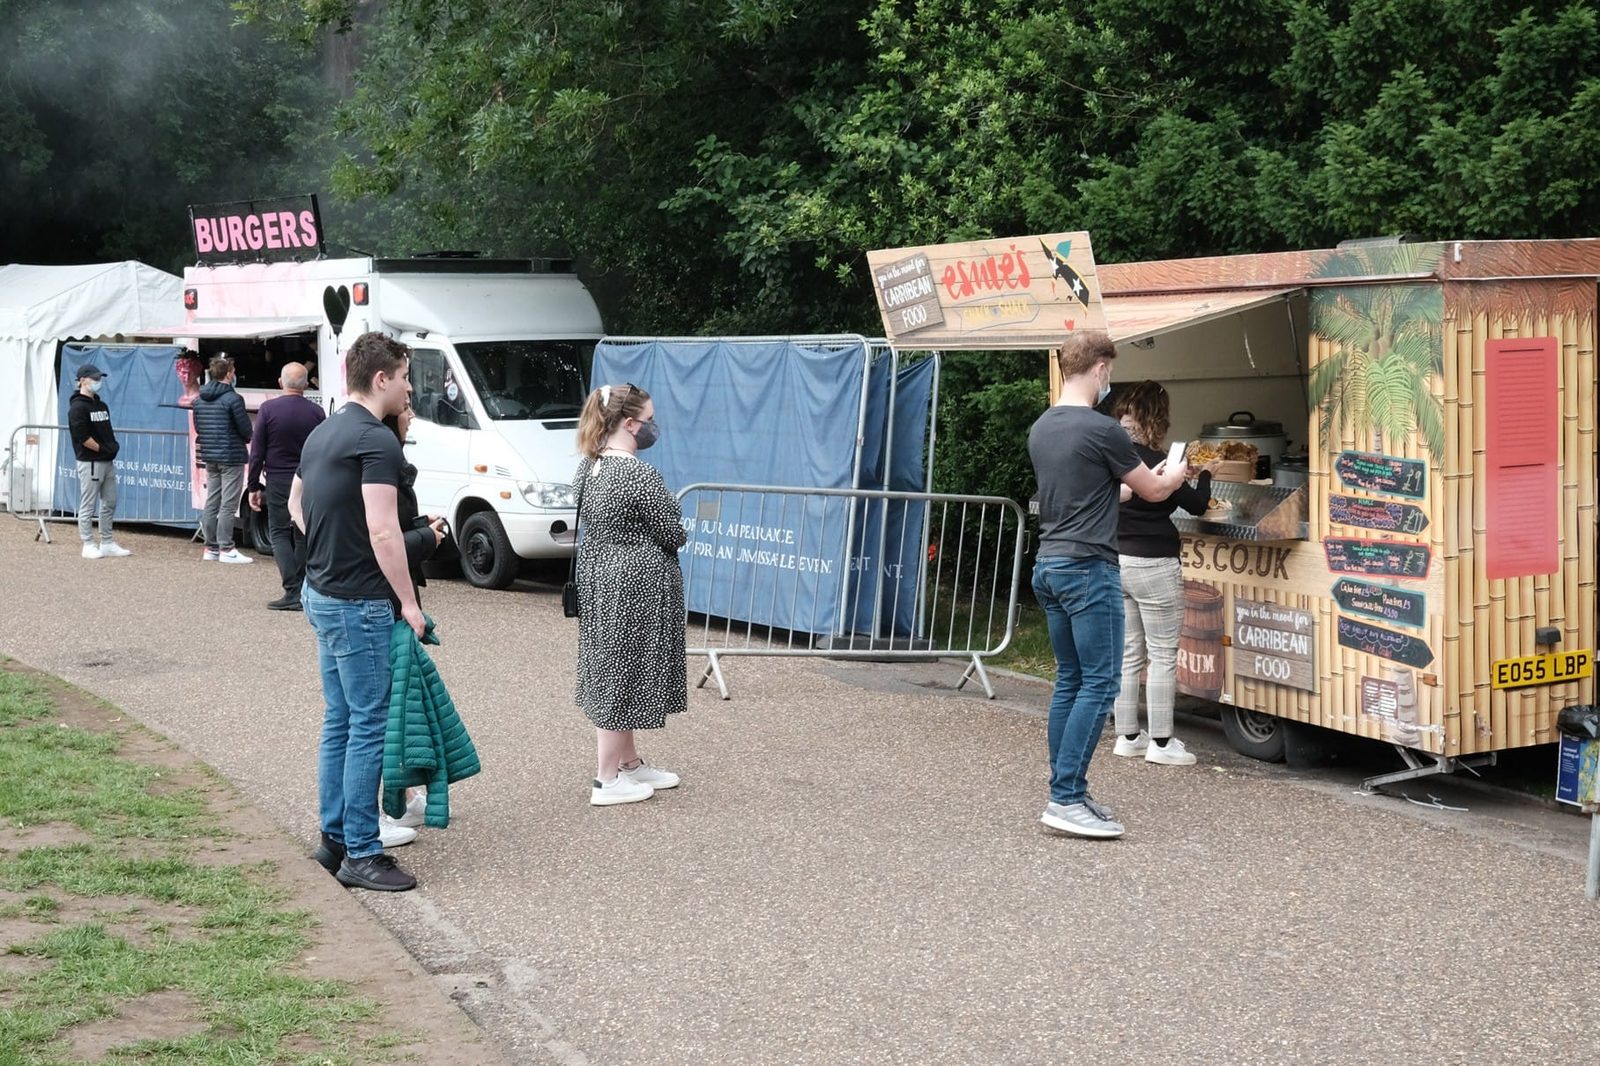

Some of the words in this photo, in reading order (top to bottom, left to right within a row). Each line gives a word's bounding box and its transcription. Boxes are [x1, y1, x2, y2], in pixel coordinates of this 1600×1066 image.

[195, 210, 317, 253] BURGERS
[884, 275, 932, 308] CARRIBEAN
[902, 304, 927, 328] FOOD
[694, 541, 713, 557] FOR
[716, 545, 733, 559] AN
[1236, 607, 1249, 622] you
[1251, 607, 1259, 618] in
[1260, 606, 1271, 620] the
[1272, 611, 1293, 623] mood
[1294, 613, 1309, 630] for
[1238, 625, 1307, 655] CARRIBEAN
[1177, 648, 1215, 673] RUM
[1255, 656, 1290, 679] FOOD
[1554, 654, 1587, 677] LBP
